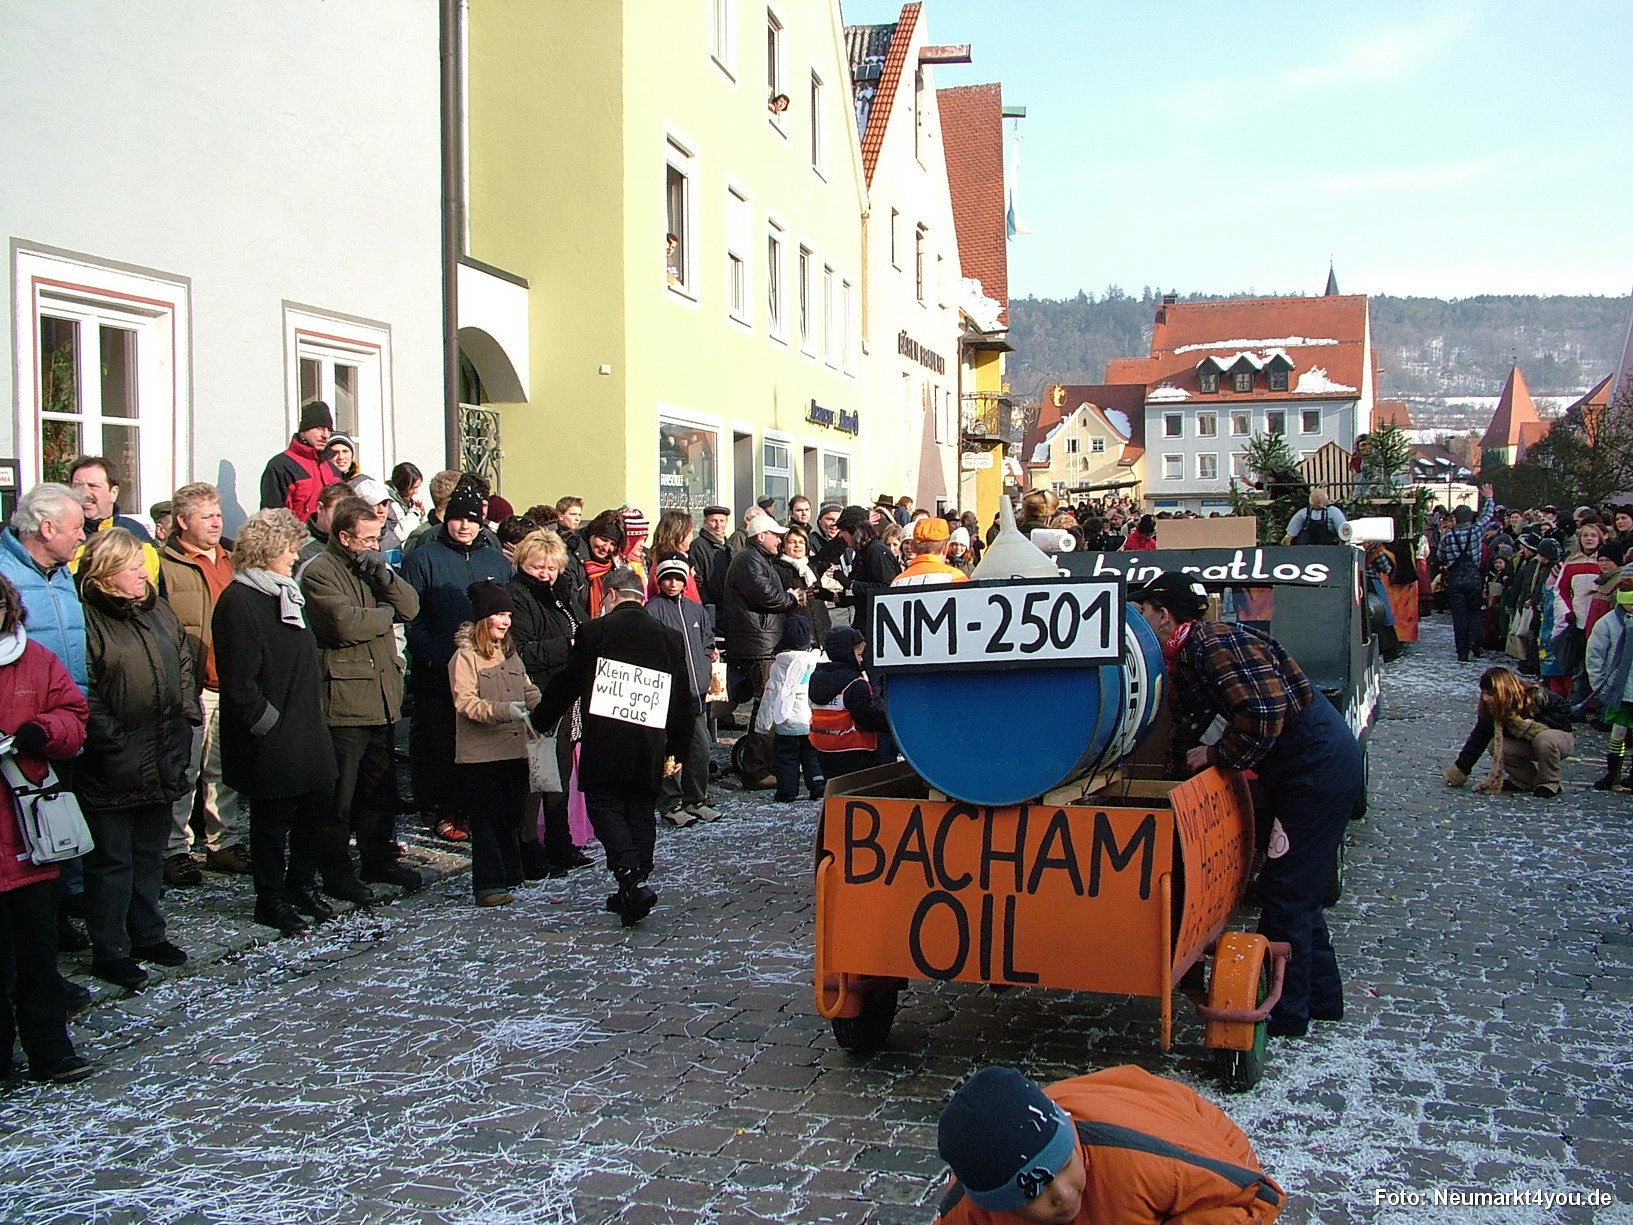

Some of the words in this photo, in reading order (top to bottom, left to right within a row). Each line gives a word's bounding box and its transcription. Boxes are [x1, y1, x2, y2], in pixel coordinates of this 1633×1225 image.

[597, 658, 630, 682] Klein
[634, 668, 665, 689] Rudi
[597, 681, 624, 698] will
[629, 691, 660, 710] groß
[612, 706, 647, 722] raus
[844, 801, 1156, 900] BACHAM
[909, 890, 1039, 984] OIL
